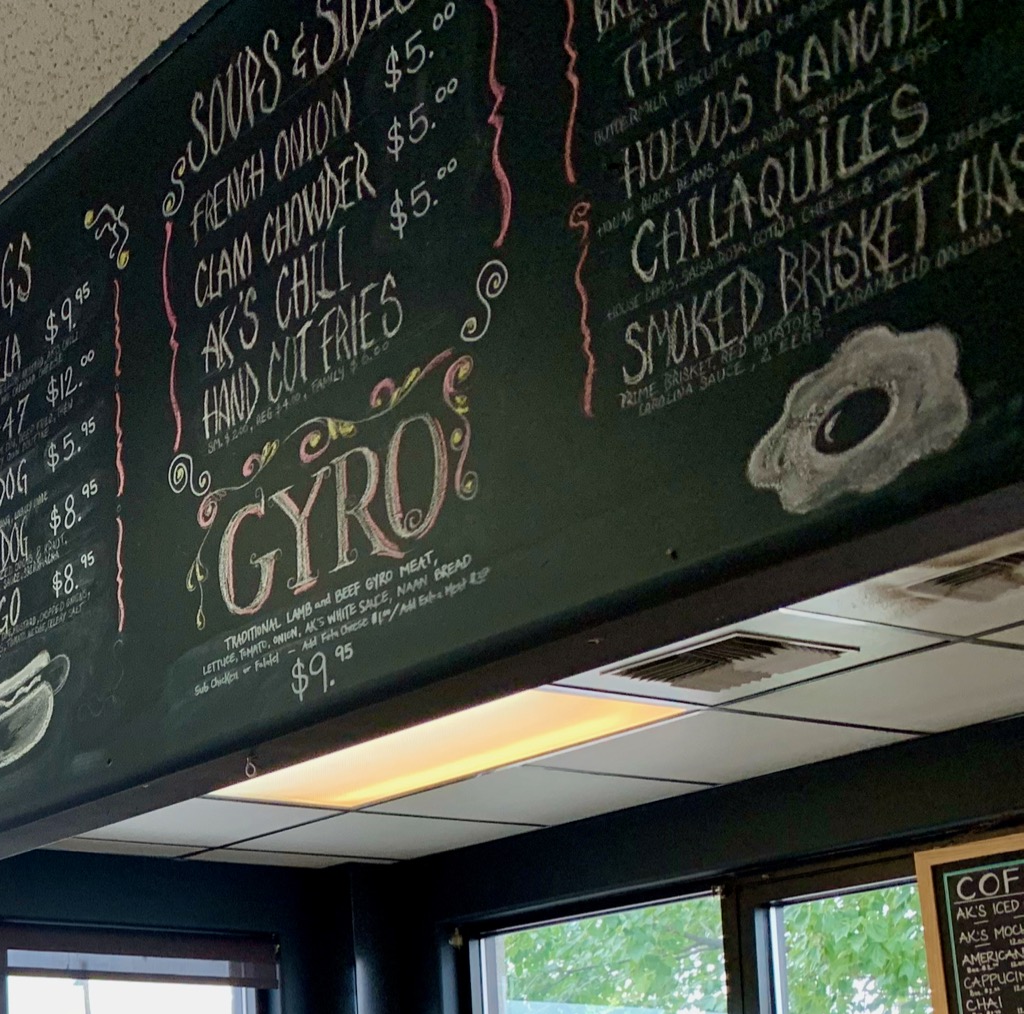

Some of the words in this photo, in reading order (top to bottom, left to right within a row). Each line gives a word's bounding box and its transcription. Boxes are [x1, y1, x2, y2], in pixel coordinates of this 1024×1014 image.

[188, 29, 280, 172] SOUPS
[190, 148, 265, 248] FRENCH
[275, 77, 352, 181] ONION
[195, 232, 253, 308] CLAM
[261, 141, 376, 265] CHOWDER
[622, 264, 765, 386] SMOKED
[778, 170, 941, 317] BRISKET
[202, 287, 259, 373] AK'S
[203, 362, 260, 440] HAND
[318, 271, 404, 374] FRIES
[0, 515, 30, 573] DOG
[219, 412, 448, 618] GYRO
[224, 617, 282, 651] TRADITIONAL
[286, 602, 313, 624] LAMB
[334, 581, 362, 604] BEEF
[365, 570, 394, 591] GYRO
[327, 600, 358, 624] WHITE
[396, 574, 429, 597] NAAN
[433, 553, 472, 581] BREAD
[291, 641, 354, 702] $9.95
[992, 899, 1020, 916] ICED
[966, 995, 1004, 1012] CHAI
